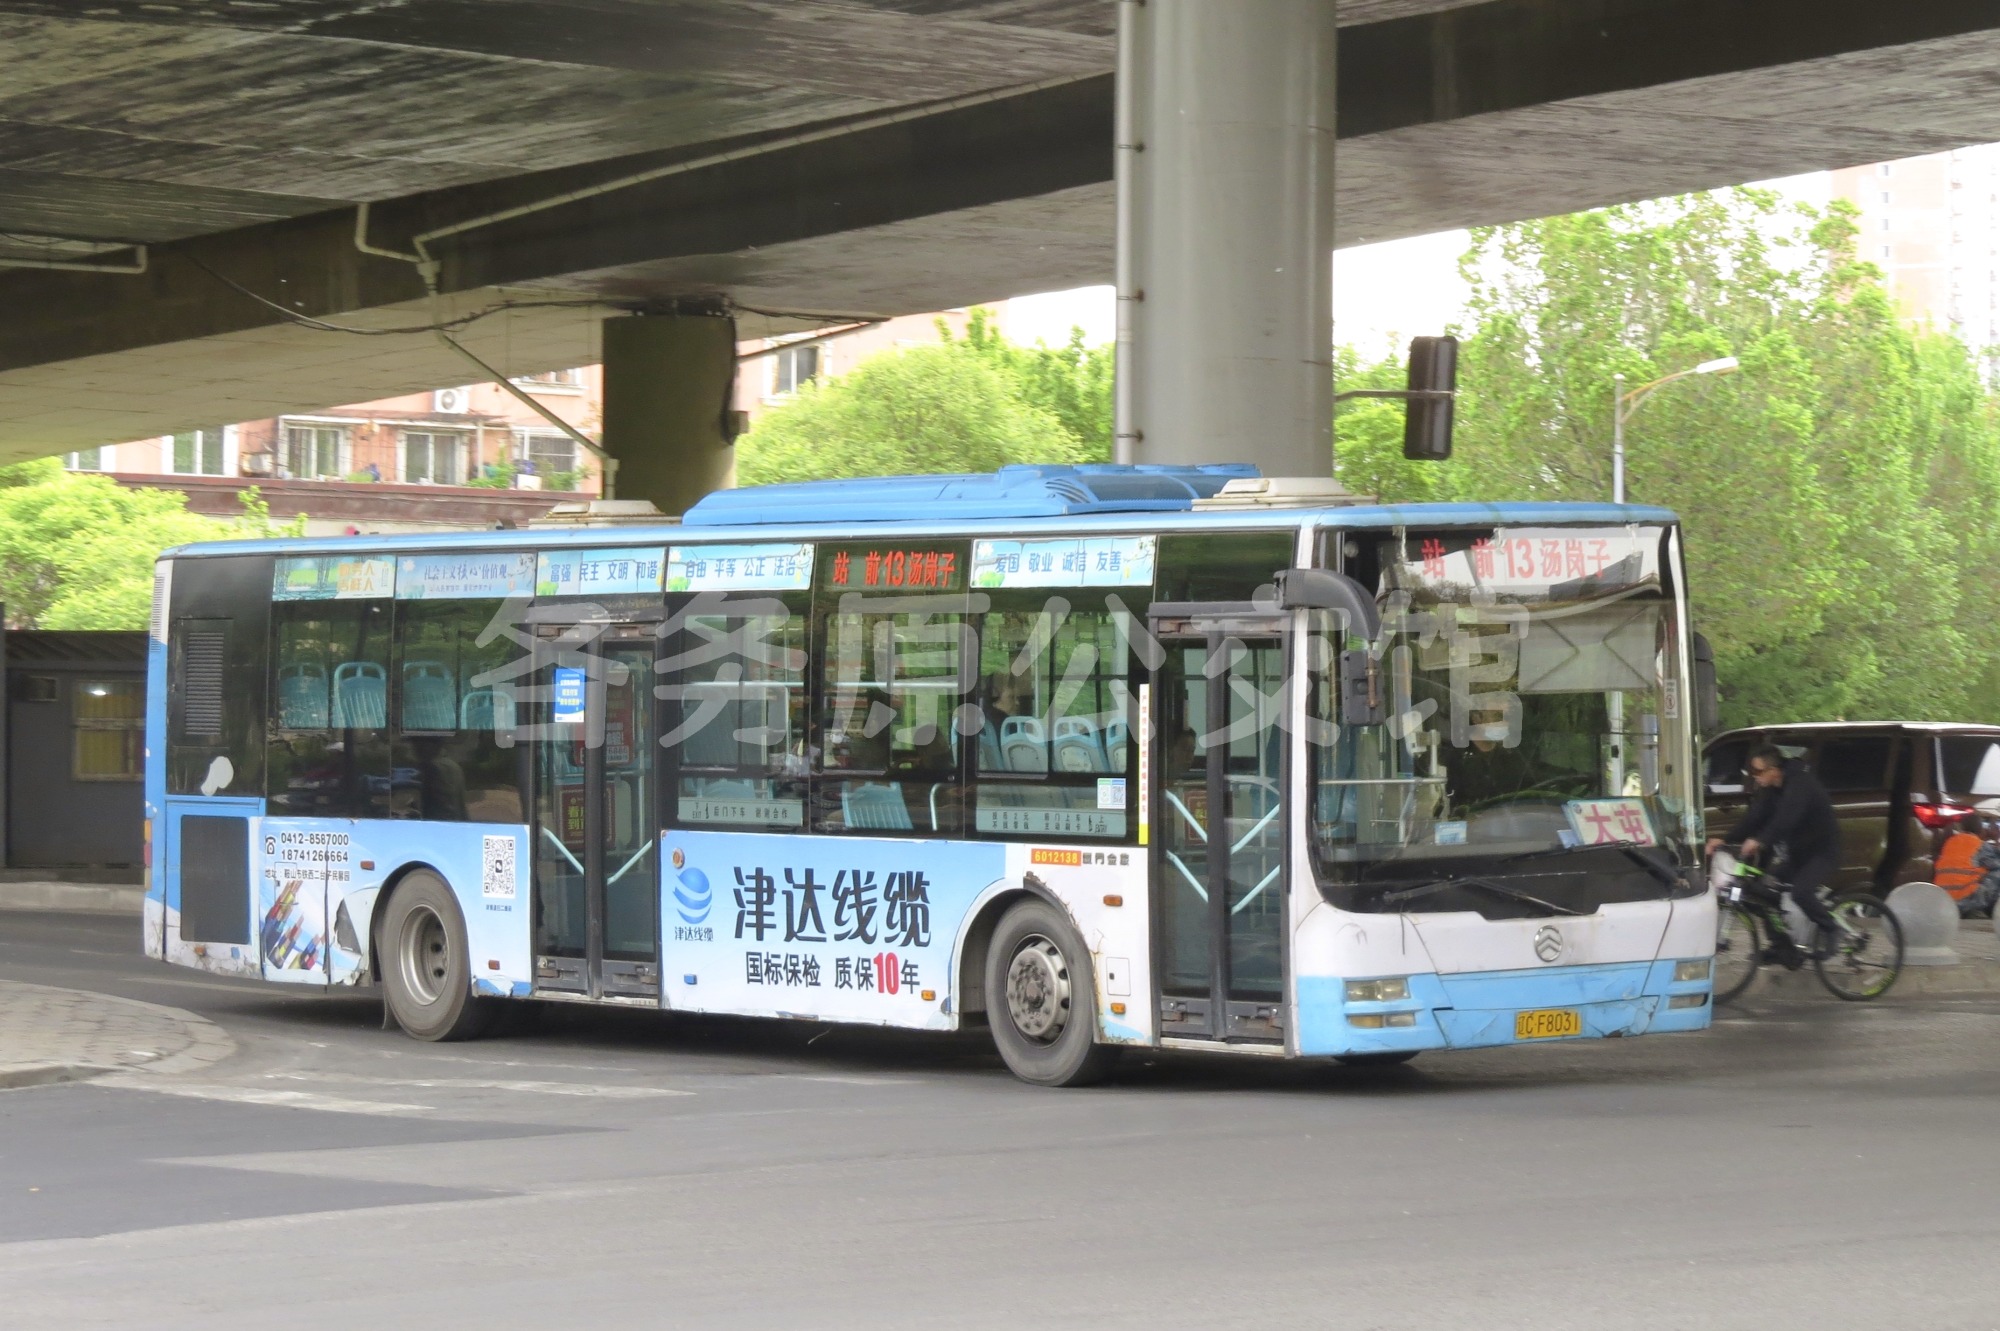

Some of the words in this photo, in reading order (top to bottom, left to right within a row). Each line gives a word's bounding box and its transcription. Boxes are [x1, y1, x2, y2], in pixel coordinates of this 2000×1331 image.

[685, 559, 707, 579] 自由
[714, 558, 736, 578] 平等
[744, 556, 765, 577] 公正
[773, 556, 796, 577] 法治
[833, 551, 849, 585] 站
[995, 553, 1020, 575] 爱国
[1028, 551, 1053, 573] 敬业
[1062, 551, 1087, 573] 诚信
[1097, 550, 1123, 572] 友善
[1421, 538, 1446, 579] 站
[551, 563, 571, 583] 富强
[579, 562, 600, 582] 民主
[607, 561, 629, 580] 文明
[636, 560, 658, 580] 和谐
[281, 832, 349, 846] 0412-8587000
[281, 849, 349, 862] 18741266664
[1034, 850, 1078, 864] 6012138
[733, 866, 932, 948] 津达线缆
[674, 926, 714, 942] 津达线缆
[745, 951, 822, 988] 国标保检
[834, 951, 921, 995] 质保10年
